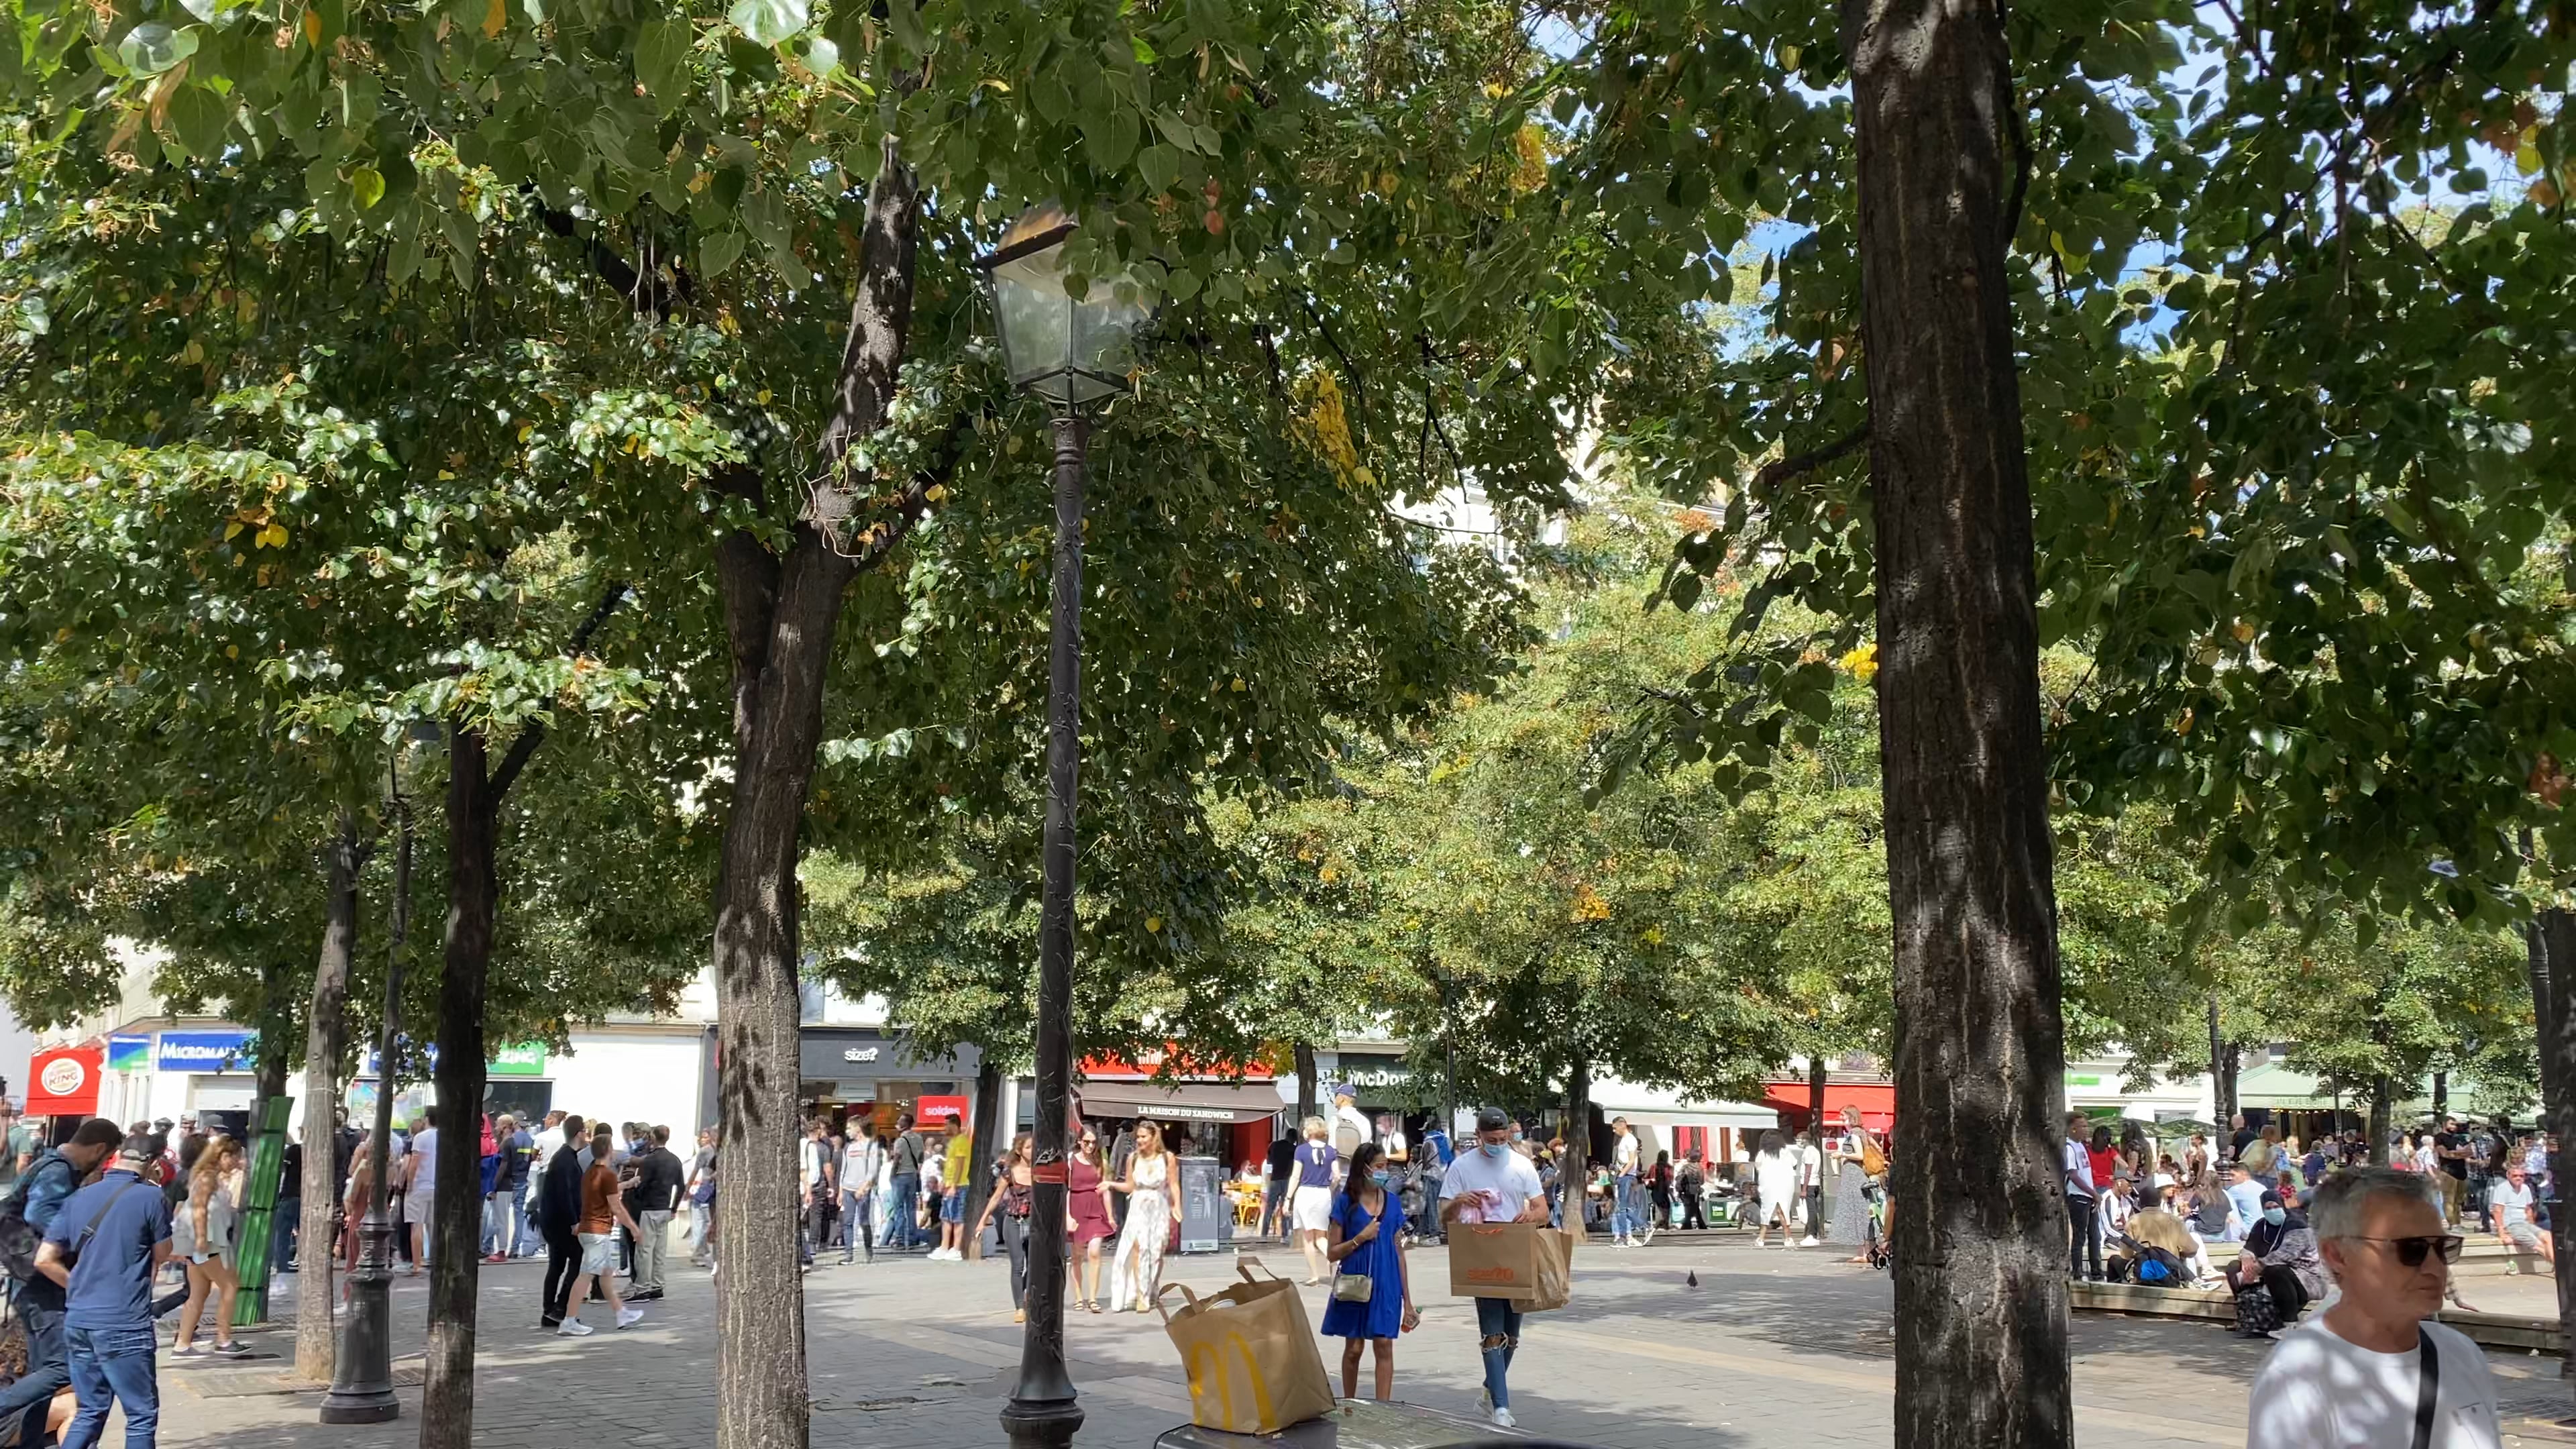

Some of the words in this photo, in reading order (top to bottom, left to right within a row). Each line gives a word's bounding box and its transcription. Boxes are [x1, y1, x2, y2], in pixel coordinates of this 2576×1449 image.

[845, 1046, 878, 1061] size?
[924, 1105, 961, 1116] soldes
[1138, 1106, 1148, 1114] LA
[1149, 1107, 1180, 1116] MAISON
[1181, 1109, 1191, 1117] DU
[1192, 1110, 1234, 1119] SANDWICH
